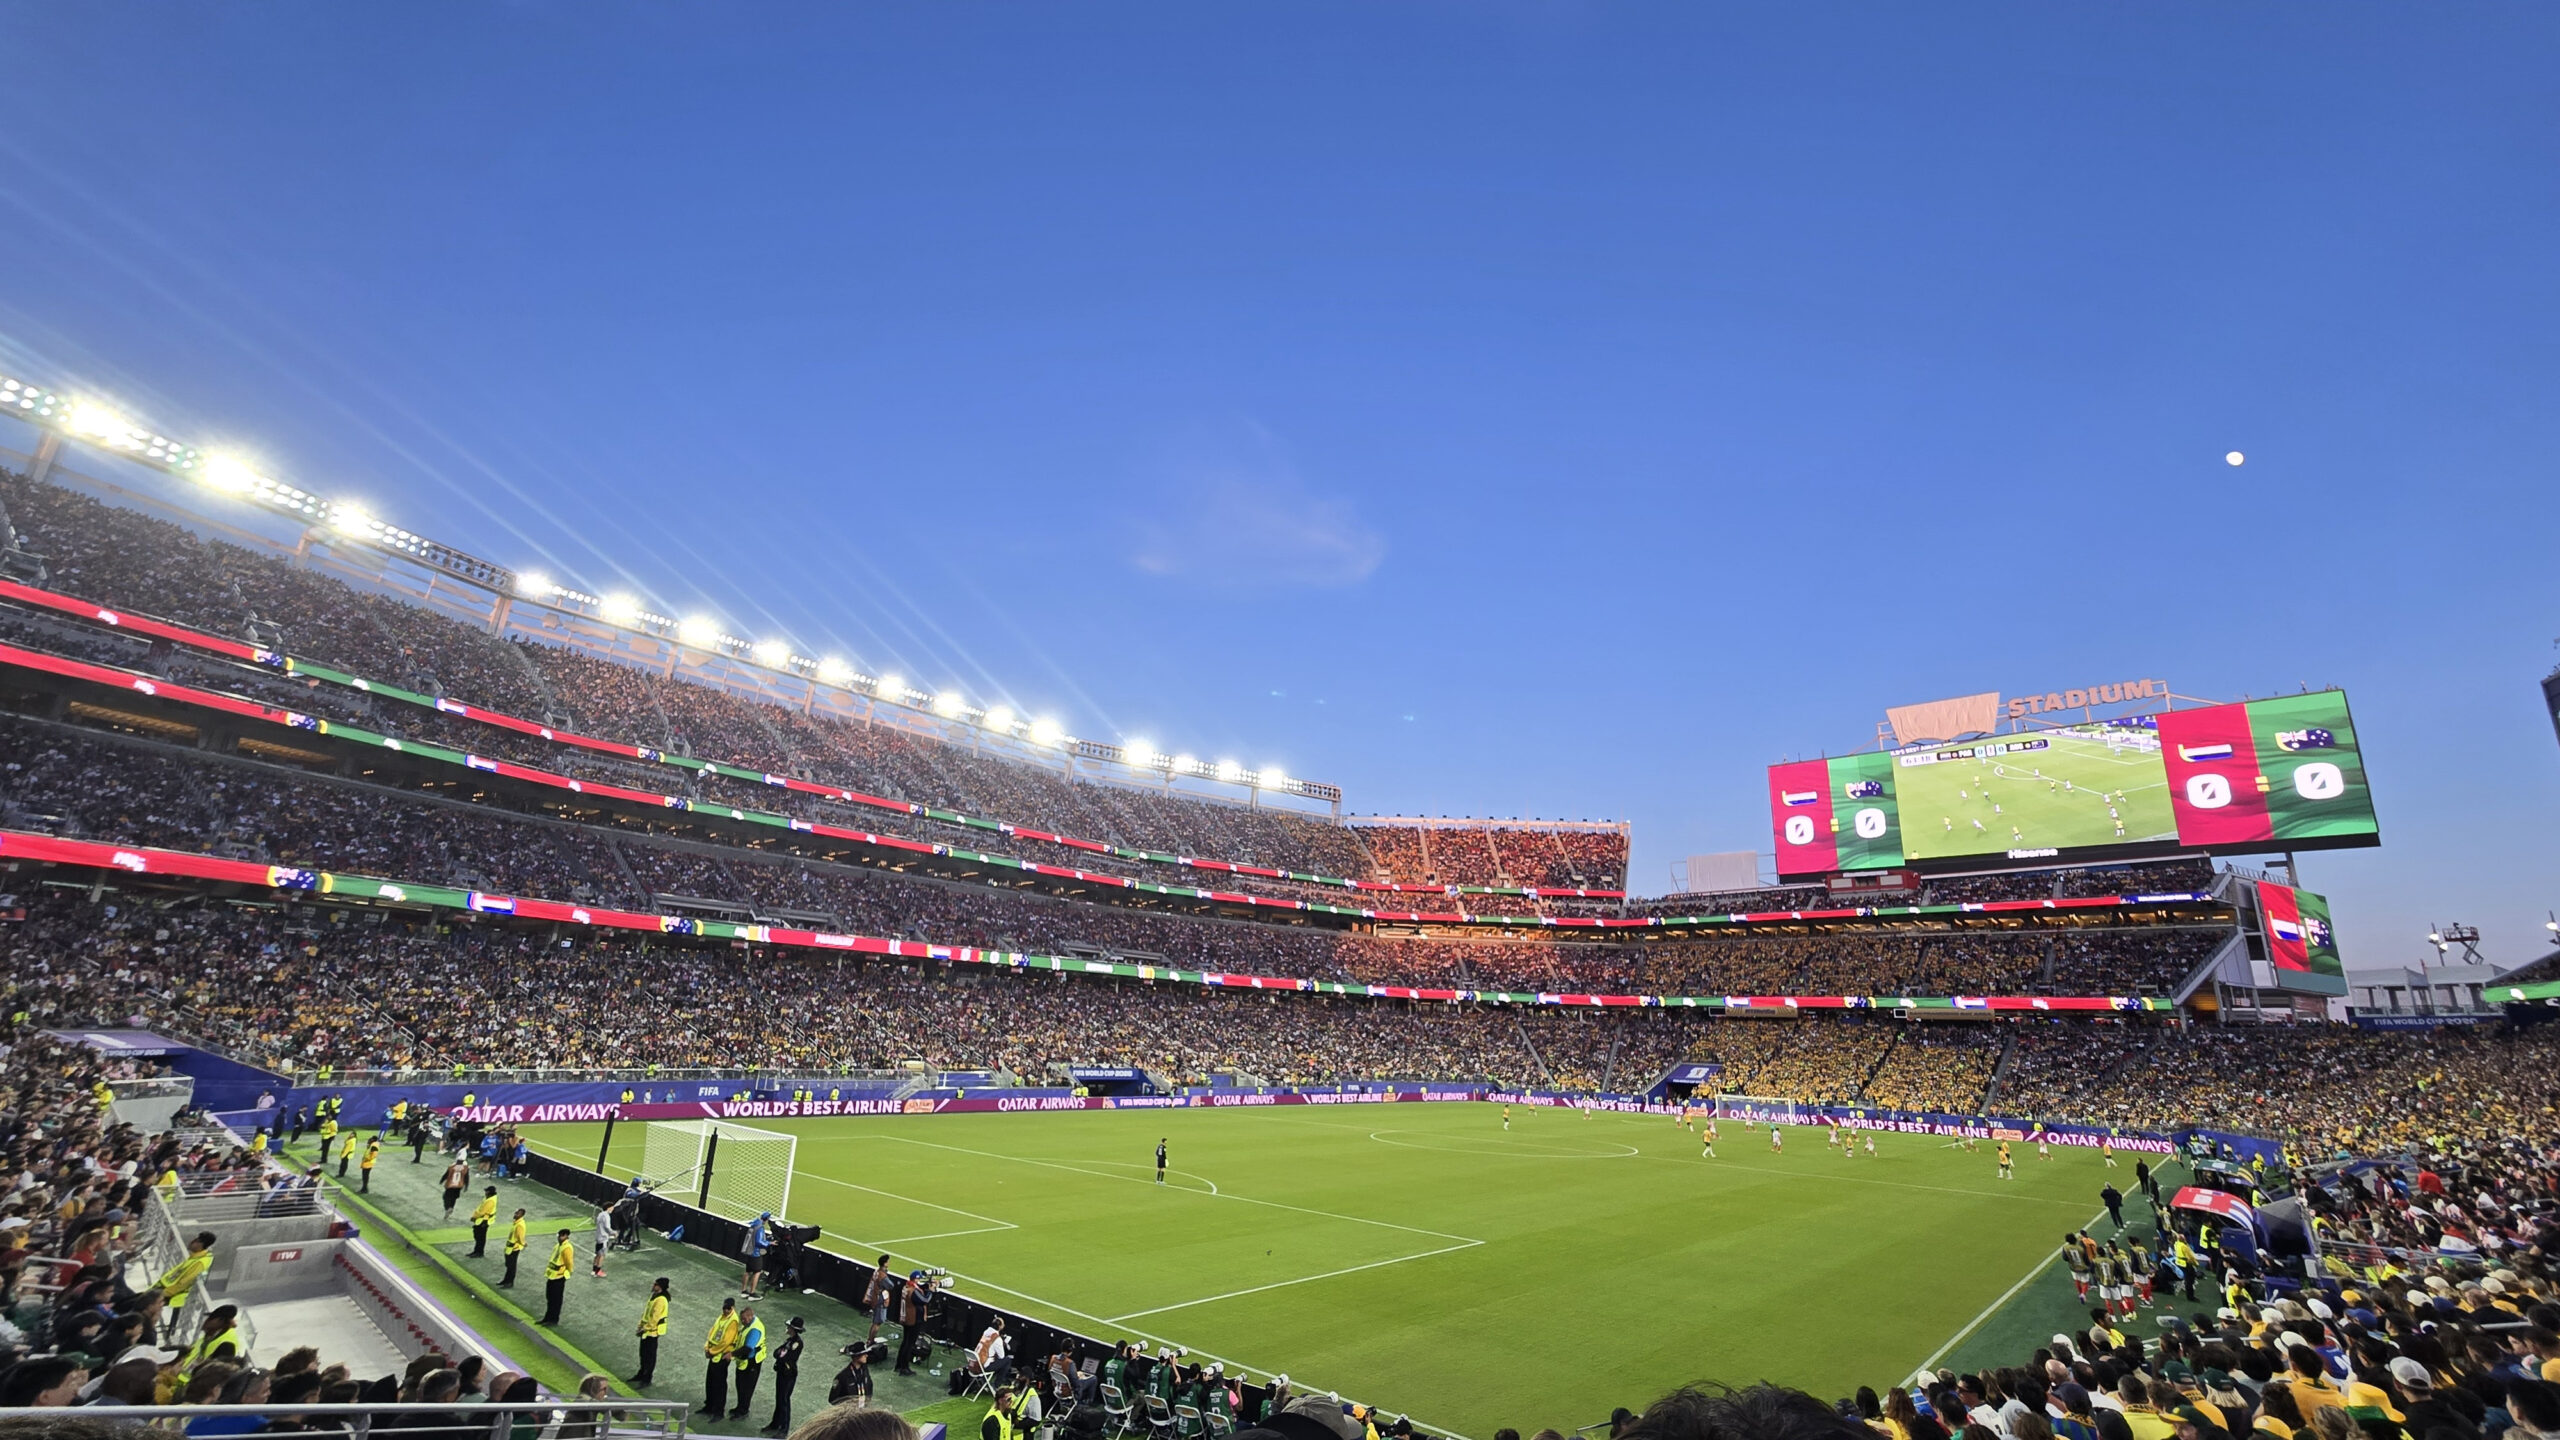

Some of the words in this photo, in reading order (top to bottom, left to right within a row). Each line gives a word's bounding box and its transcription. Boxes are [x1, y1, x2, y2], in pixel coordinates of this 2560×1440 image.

[2008, 679, 2152, 718] STADIUM
[2186, 774, 2232, 809] 0
[2293, 762, 2345, 800] 0
[1785, 815, 1815, 845] 0
[1855, 808, 1887, 839] 0
[698, 1086, 719, 1097] FIFA
[1311, 1094, 1341, 1104] WORLD'S
[1341, 1093, 1358, 1103] BEST
[1358, 1092, 1382, 1102] AIRLINE
[1422, 1092, 1441, 1102] QATAR
[1442, 1092, 1468, 1101] AIRWAYS
[1488, 1093, 1517, 1103] QATAR
[1519, 1095, 1555, 1106] AIRWAYS
[722, 1101, 799, 1117] WORLD'S
[803, 1100, 841, 1115] BEST
[844, 1099, 902, 1114] AIRLINE
[998, 1098, 1038, 1112] QATAR
[1040, 1096, 1086, 1110] AIRWAYS
[1213, 1095, 1241, 1107] QATAR
[1242, 1094, 1275, 1105] AIRWAYS
[1574, 1099, 1617, 1111] WORLD'S
[1618, 1101, 1642, 1113] BEST
[1643, 1104, 1683, 1116] AIRLINE
[450, 1105, 525, 1123] QATAR
[530, 1103, 621, 1121] AIRWAYS
[1838, 1117, 1896, 1132] WORLD'S
[1898, 1121, 1931, 1134] BEST
[1987, 1120, 2005, 1129] IFA
[2047, 1131, 2100, 1147] QATAR
[2105, 1136, 2172, 1154] AIRWAYS
